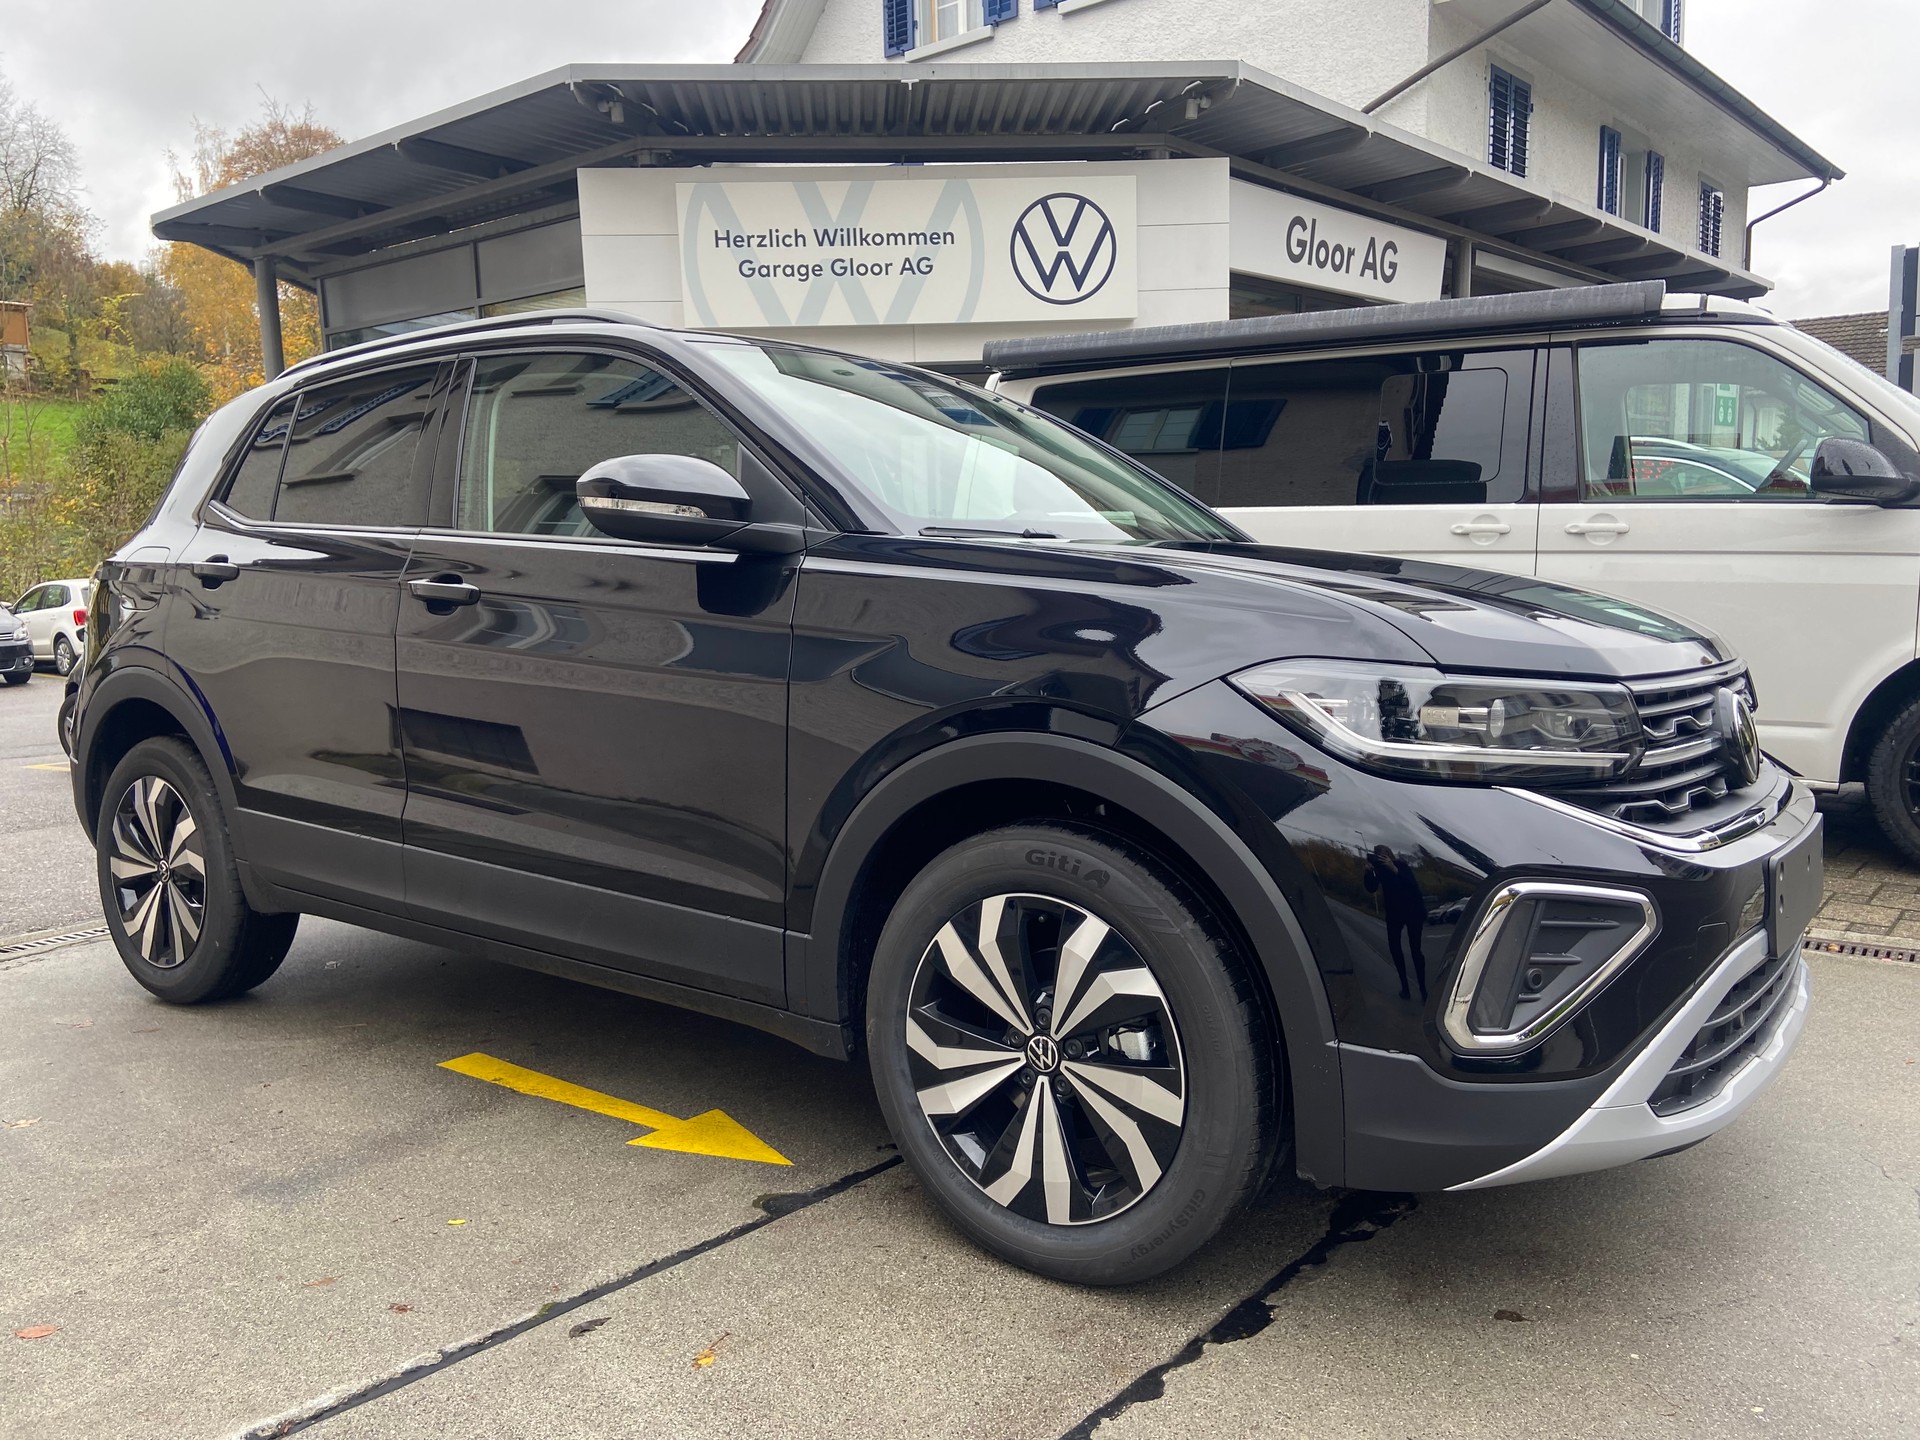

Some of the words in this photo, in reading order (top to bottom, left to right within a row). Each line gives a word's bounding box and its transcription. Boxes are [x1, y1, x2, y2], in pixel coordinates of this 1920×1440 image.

[714, 228, 807, 249] Herzlich
[813, 227, 955, 247] Willkommen
[1286, 215, 1355, 274] Gloor
[1359, 236, 1398, 284] AG
[738, 259, 824, 282] Garage
[830, 257, 893, 277] Gloor
[899, 256, 934, 276] AG
[1025, 848, 1082, 877] Giti
